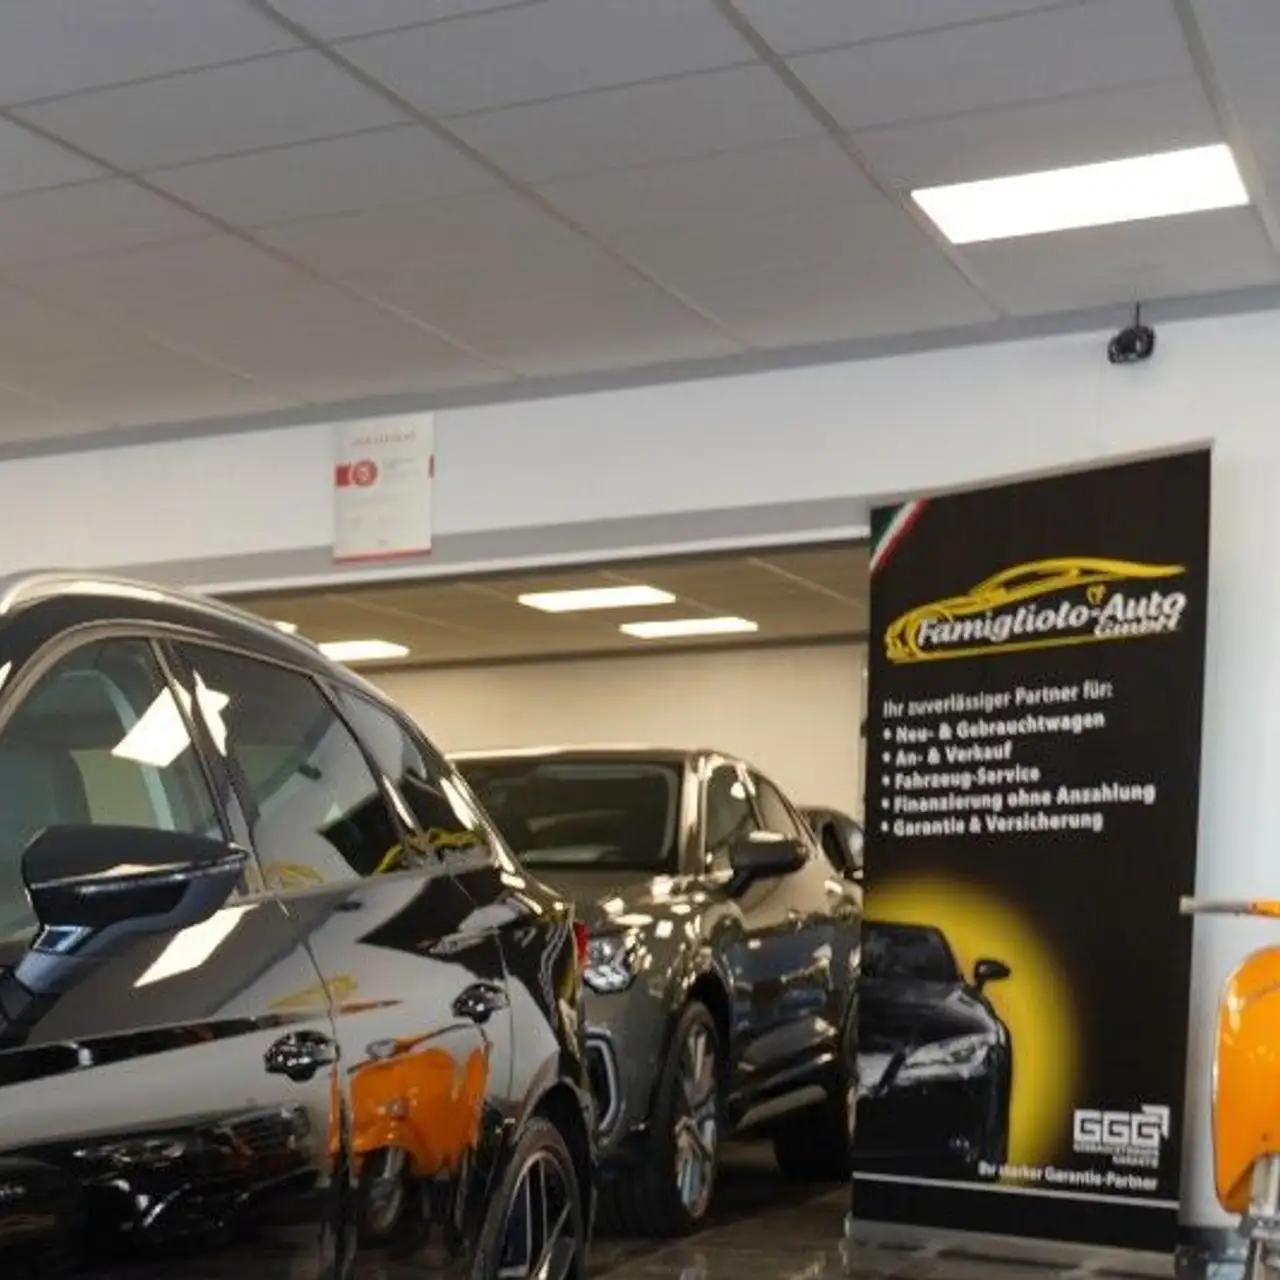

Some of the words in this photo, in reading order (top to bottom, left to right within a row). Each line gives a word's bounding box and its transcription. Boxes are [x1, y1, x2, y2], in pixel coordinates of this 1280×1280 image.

[883, 700, 903, 718] Ihr
[907, 691, 1011, 716] zuverlässiger
[1015, 685, 1079, 706] Partner
[895, 727, 934, 743] Neu-
[938, 722, 952, 740] &
[956, 711, 1106, 738] Gebrauchtwagen
[895, 750, 923, 767] An-
[945, 739, 1013, 763] Verkauf
[895, 763, 1041, 790] Fahrzeug-Service
[894, 792, 1003, 813] Finanzierung
[1007, 787, 1052, 806] ohne
[1056, 782, 1157, 805] Anzahlung
[893, 815, 965, 837] Garantie
[985, 810, 1104, 832] Versicherung
[1073, 1104, 1170, 1146] GGG
